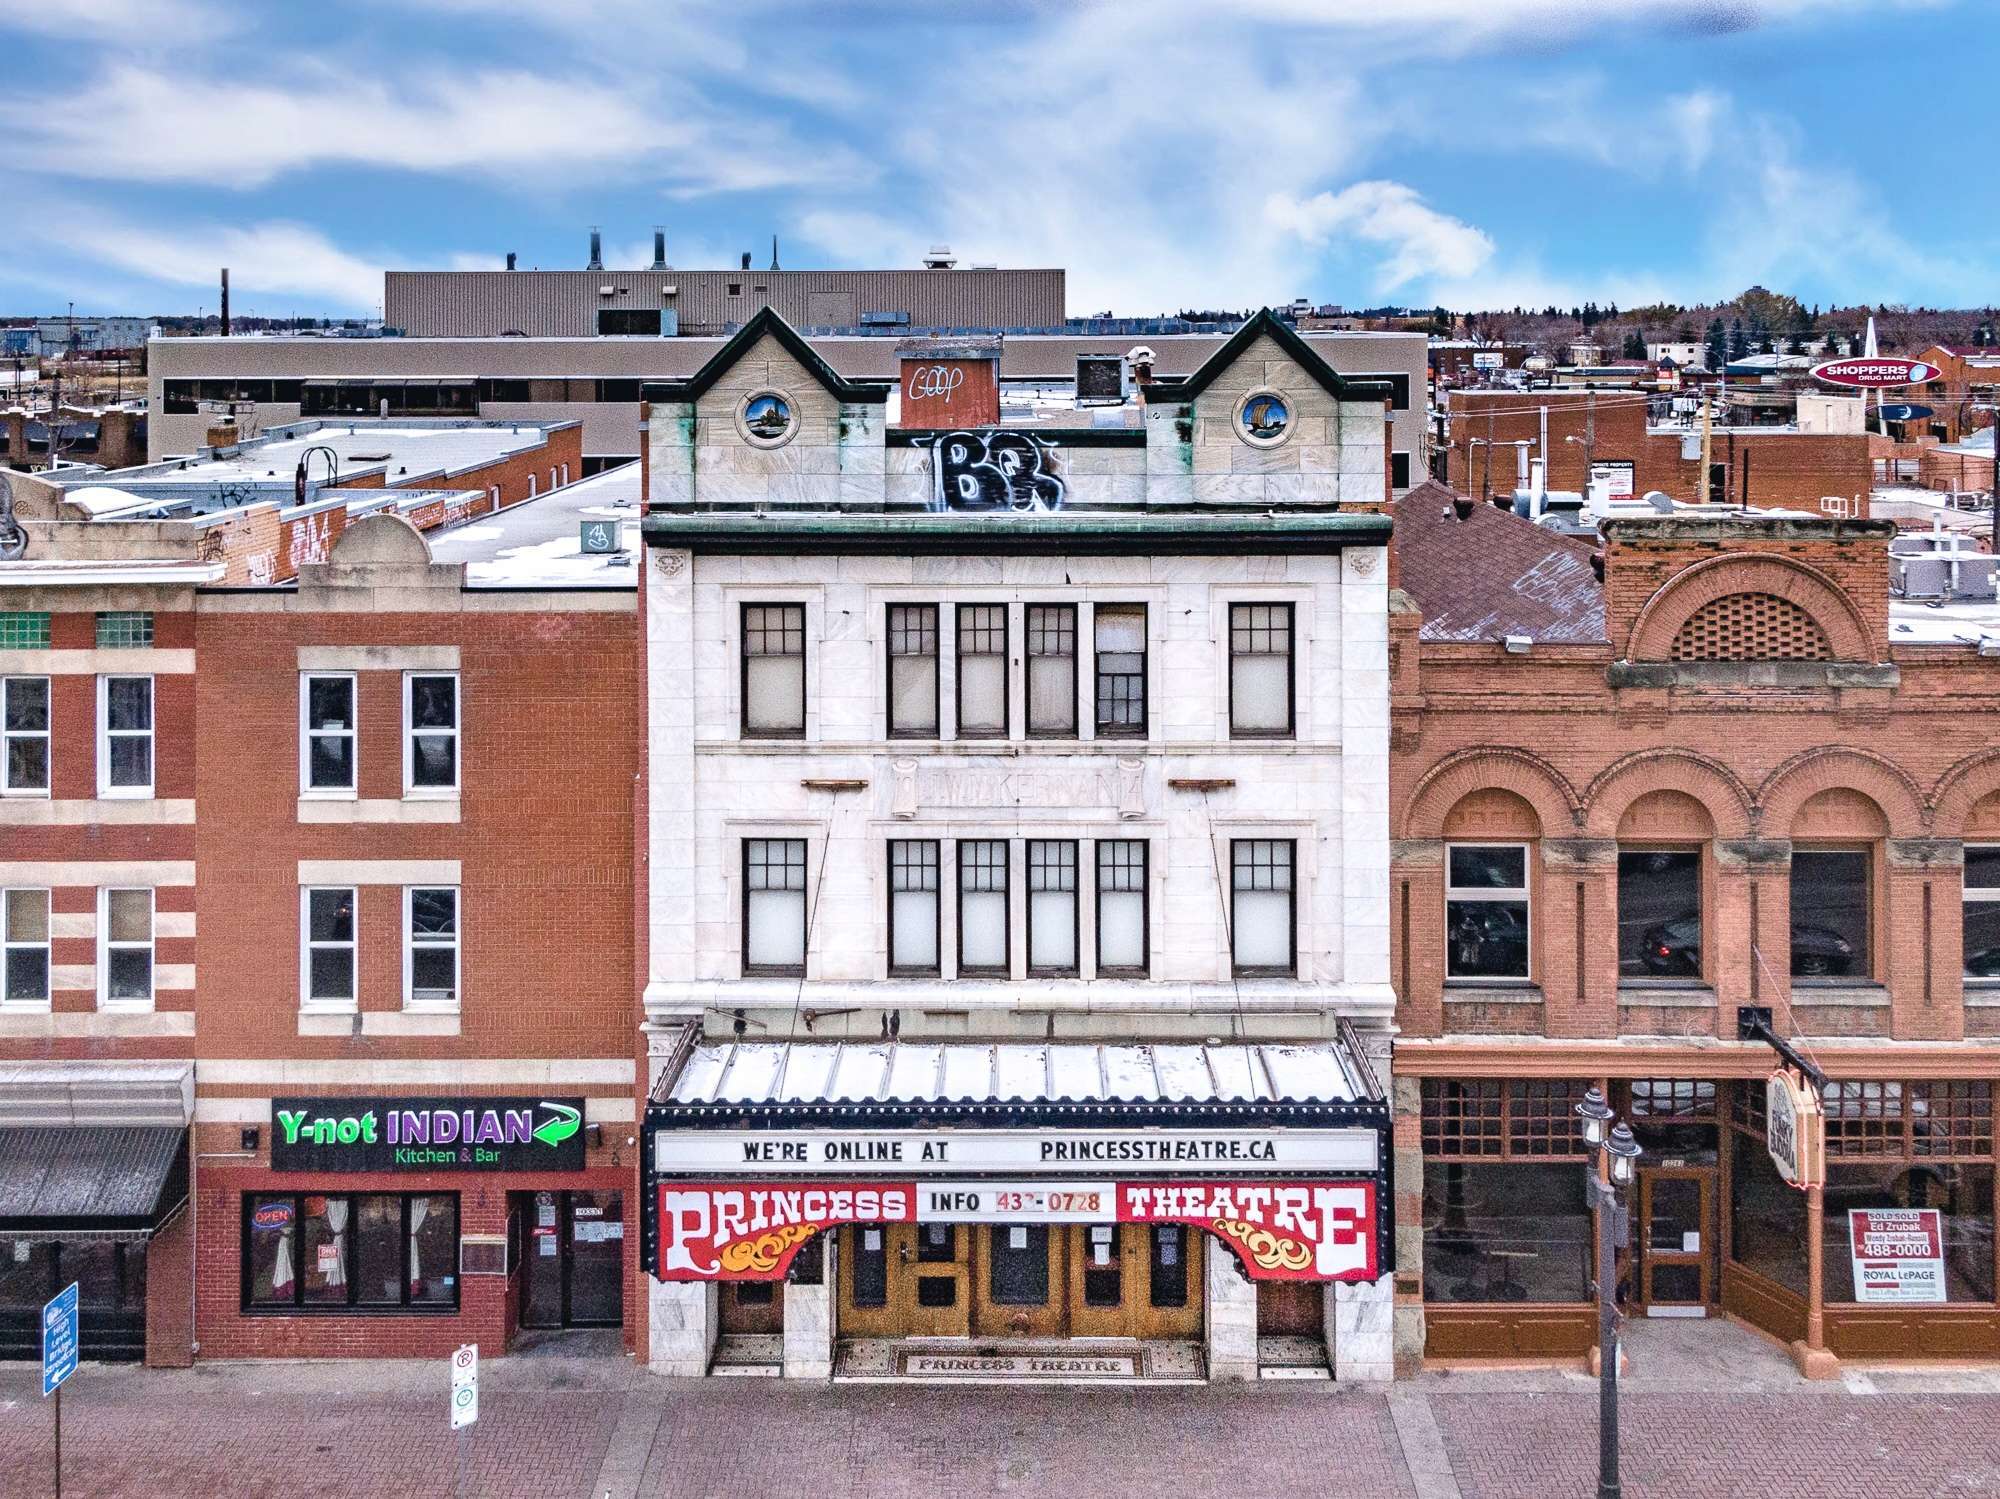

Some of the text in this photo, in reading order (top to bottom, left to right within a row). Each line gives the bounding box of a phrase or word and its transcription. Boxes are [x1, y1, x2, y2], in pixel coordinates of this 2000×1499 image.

[1827, 366, 1907, 375] SHOPPERS
[277, 1109, 533, 1145] Y-not INDIAN
[395, 1148, 500, 1163] Kitchen & Bar
[743, 1140, 1277, 1160] WE'RE ONLINE AT PRINCESSTHEATRE.CA
[931, 1192, 981, 1211] INFO
[255, 1210, 289, 1223] OPEN
[1869, 1212, 1919, 1220] SOLD SOLD
[665, 1190, 907, 1275] PRINCESS
[1126, 1187, 1367, 1276] THEATRE
[1870, 1222, 1921, 1231] Ed Zrubak
[1864, 1244, 1932, 1256] 488-0000
[1863, 1271, 1897, 1280] ROYAL
[918, 1357, 1122, 1372] PRINCESS THEATRE
